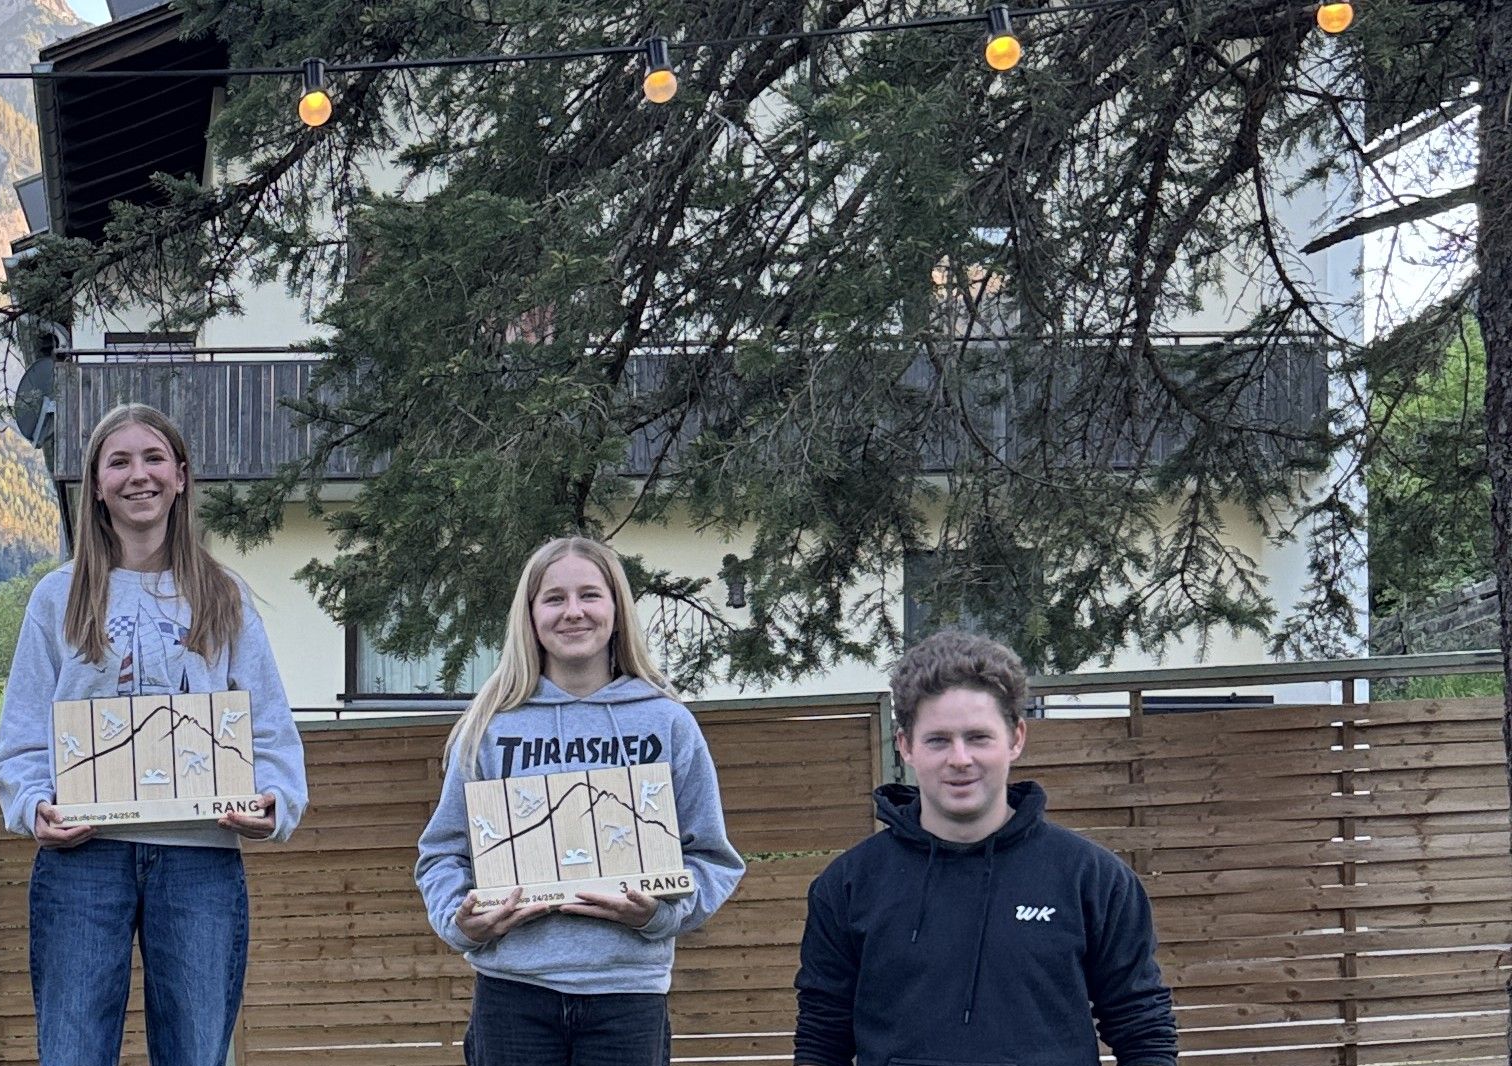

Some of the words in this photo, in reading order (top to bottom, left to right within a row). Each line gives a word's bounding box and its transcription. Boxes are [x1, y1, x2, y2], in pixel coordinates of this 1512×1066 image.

[496, 733, 663, 779] THRASHED
[212, 800, 260, 814] RANG
[640, 876, 690, 892] RANG
[1016, 905, 1056, 921] WK
